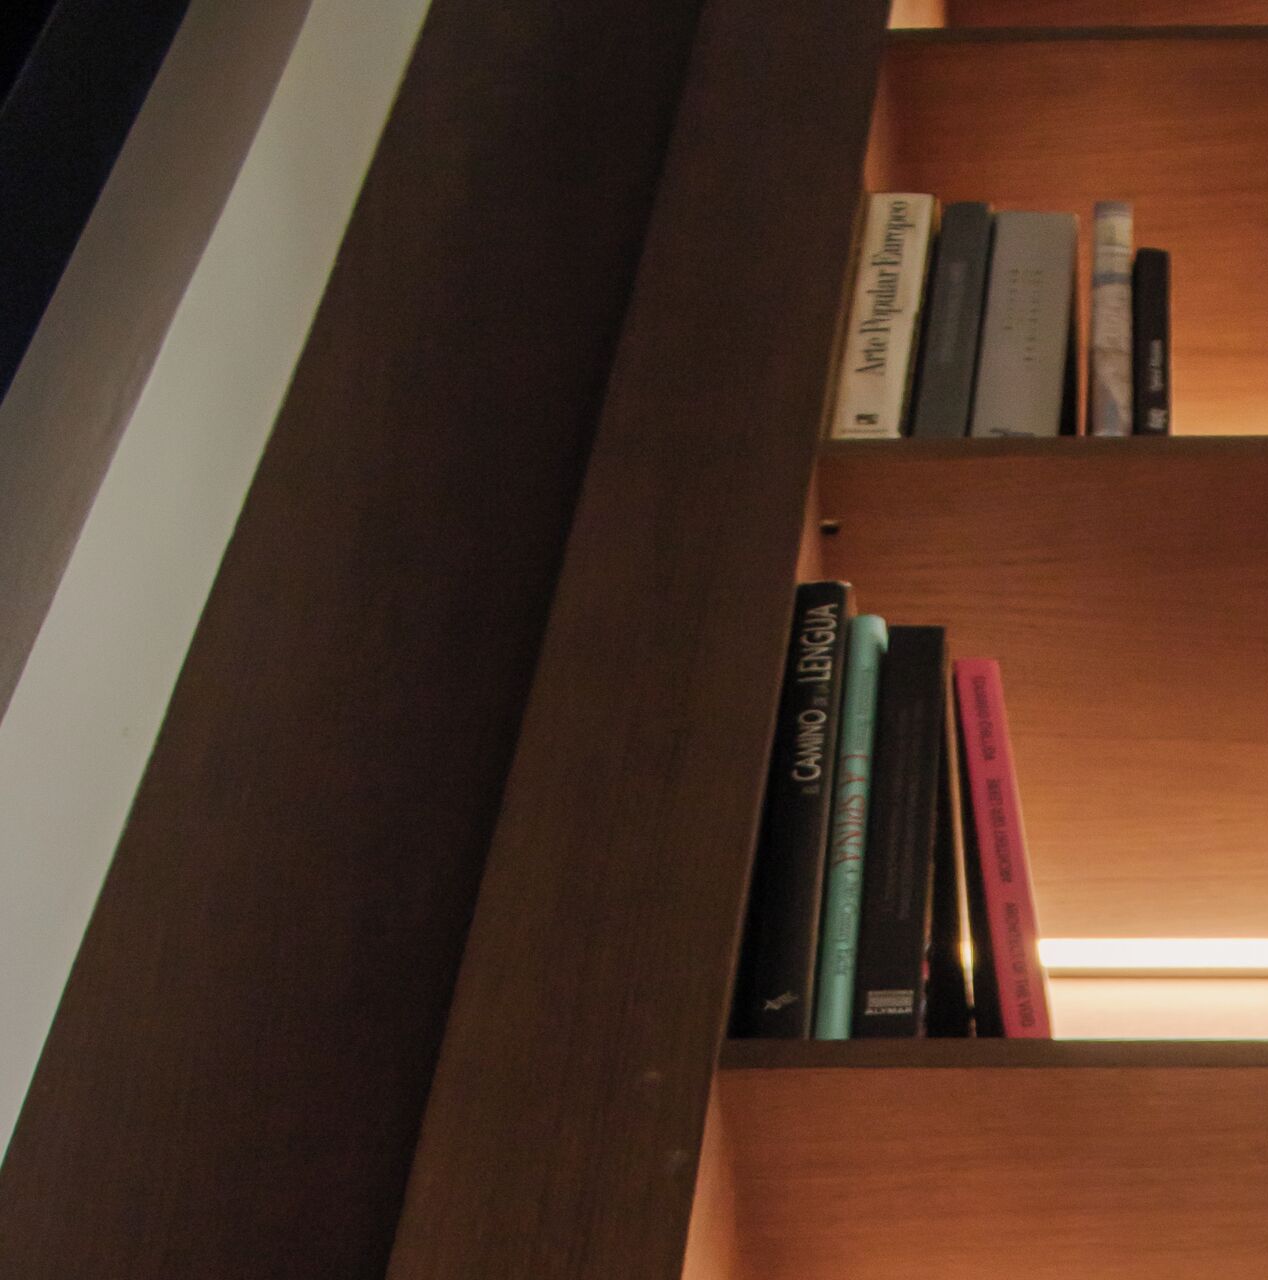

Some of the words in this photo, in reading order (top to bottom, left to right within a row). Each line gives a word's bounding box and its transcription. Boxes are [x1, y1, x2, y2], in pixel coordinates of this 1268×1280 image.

[870, 201, 919, 266] Europeo
[859, 271, 908, 333] Popular
[853, 338, 889, 375] Arte
[793, 603, 839, 683] LENGUA
[789, 709, 828, 781] CAMINO
